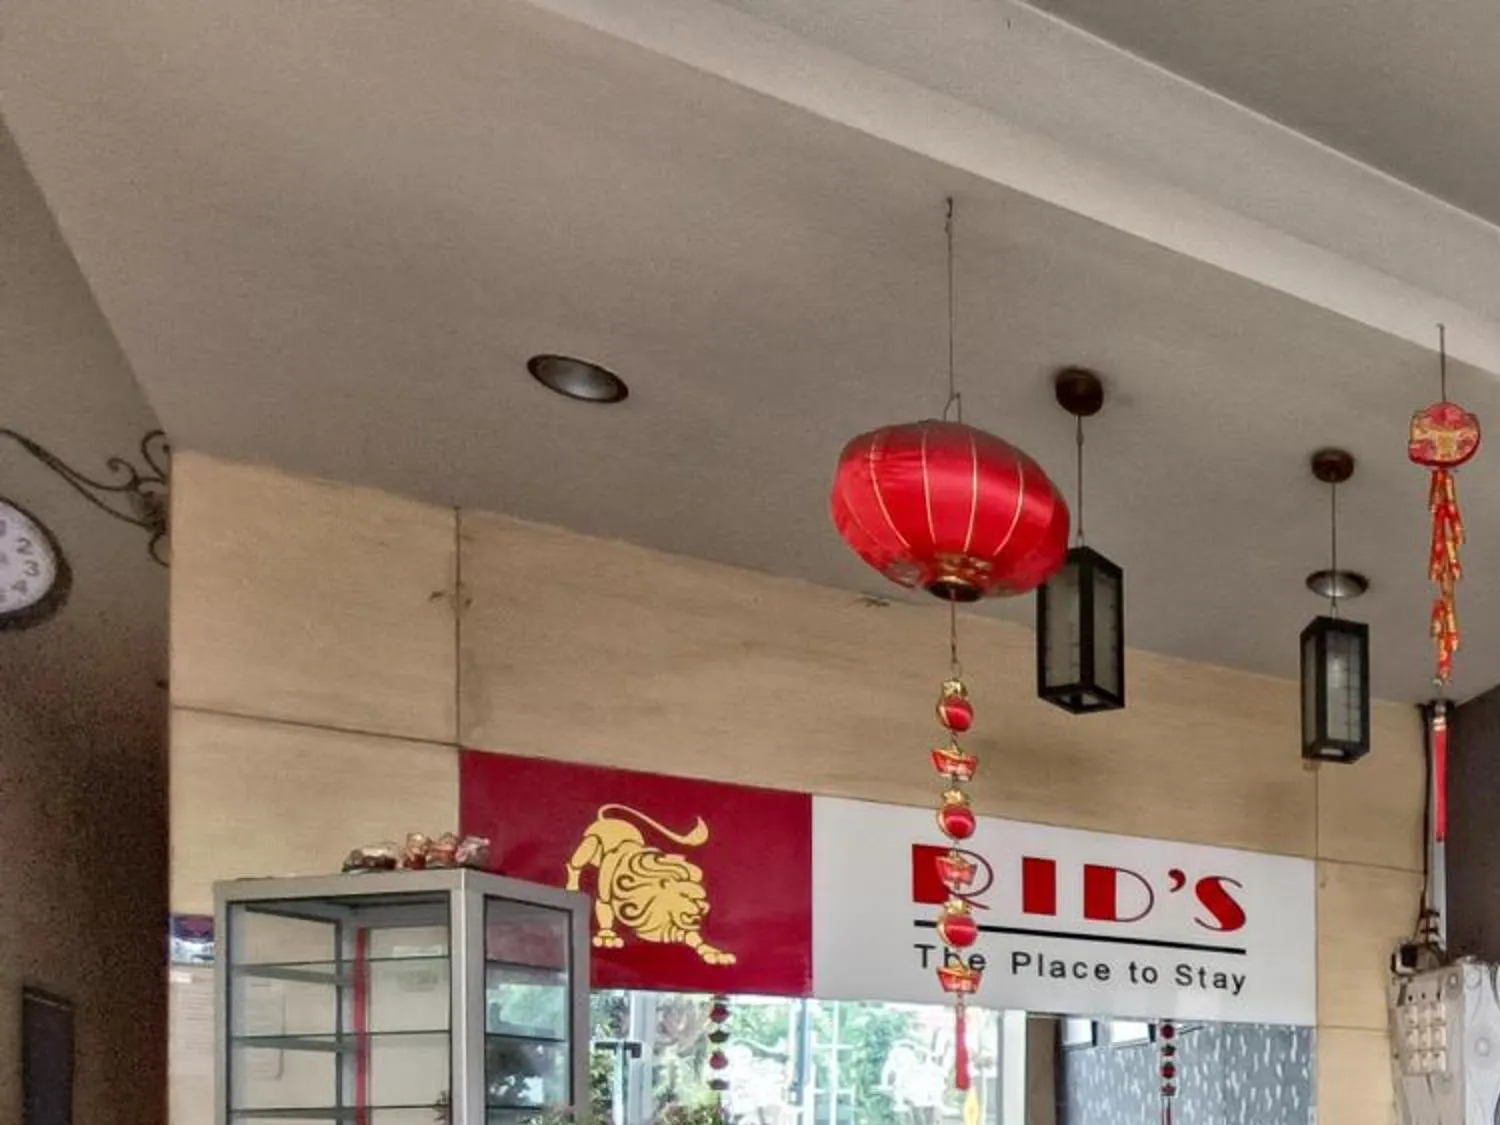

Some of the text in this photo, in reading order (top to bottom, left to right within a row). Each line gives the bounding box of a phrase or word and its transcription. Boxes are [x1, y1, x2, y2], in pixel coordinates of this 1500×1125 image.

[1011, 951, 1111, 982] Place
[1128, 960, 1159, 985] to
[1174, 964, 1247, 996] Stay
